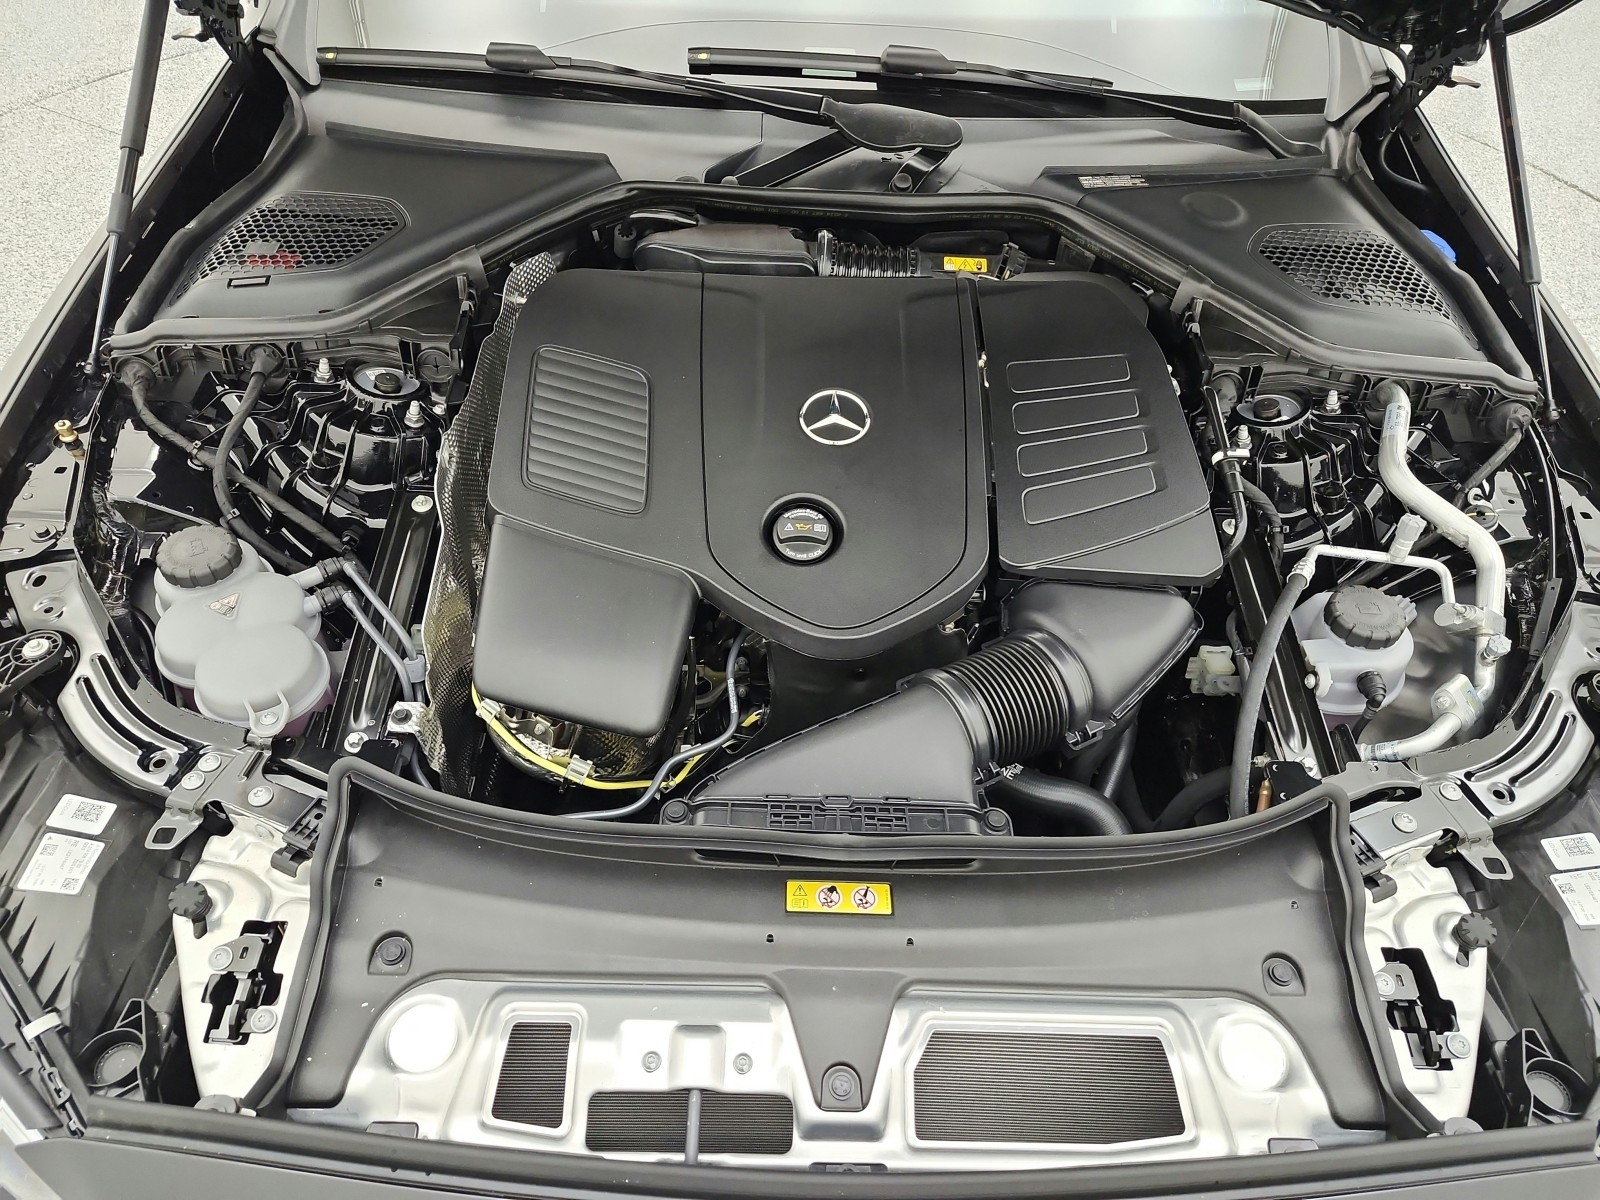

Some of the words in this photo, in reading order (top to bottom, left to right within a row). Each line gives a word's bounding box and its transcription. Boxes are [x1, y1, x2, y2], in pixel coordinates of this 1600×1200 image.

[783, 508, 818, 519] Mercedes-Benz
[785, 548, 796, 557] Turn
[808, 549, 823, 558] CLICK
